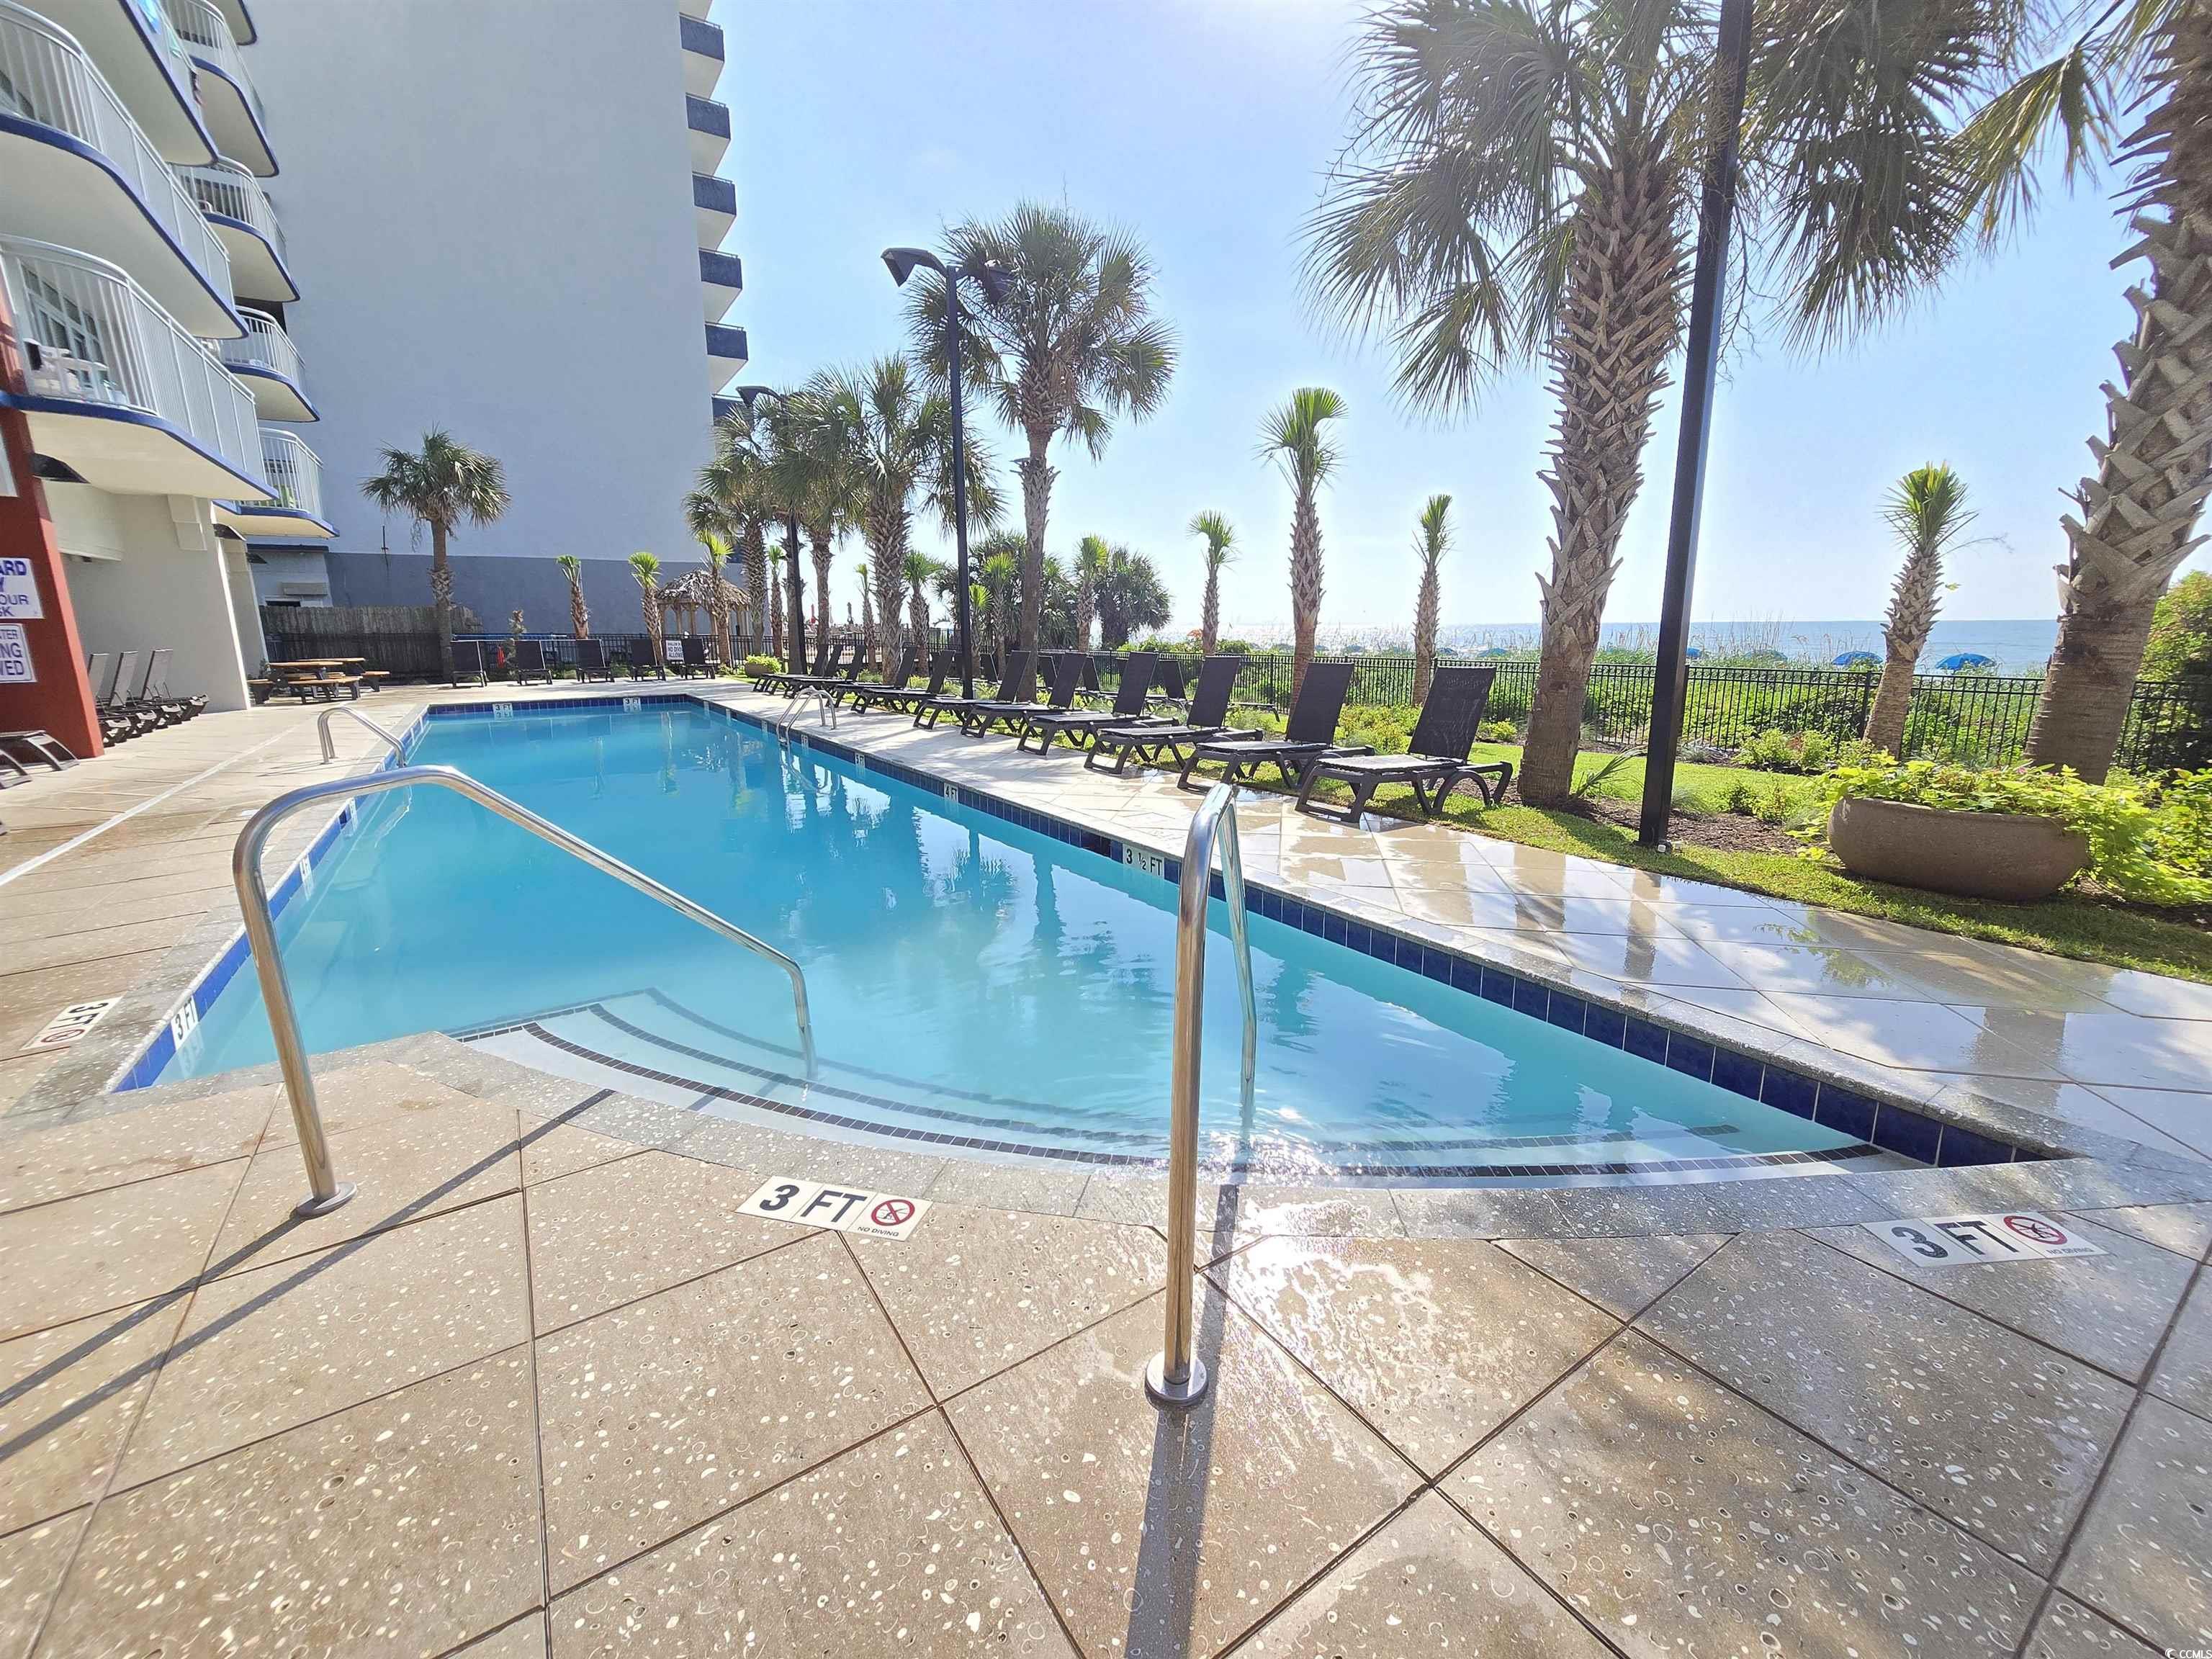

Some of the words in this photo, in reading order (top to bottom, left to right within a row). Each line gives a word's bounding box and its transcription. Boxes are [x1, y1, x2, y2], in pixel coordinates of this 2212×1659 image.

[0, 629, 18, 639] TER
[945, 786, 949, 797] 4
[951, 788, 957, 801] FT
[1126, 849, 1133, 864] 3
[1150, 856, 1162, 876] FT
[68, 1002, 109, 1013] 3
[48, 1012, 99, 1030] FT
[175, 1013, 184, 1040] 3
[184, 997, 195, 1030] FT
[759, 1184, 799, 1211] 3
[800, 1190, 868, 1223] FT
[871, 1228, 899, 1236] DIVING
[1891, 1226, 1948, 1258] 3
[1934, 1220, 2019, 1255] FT
